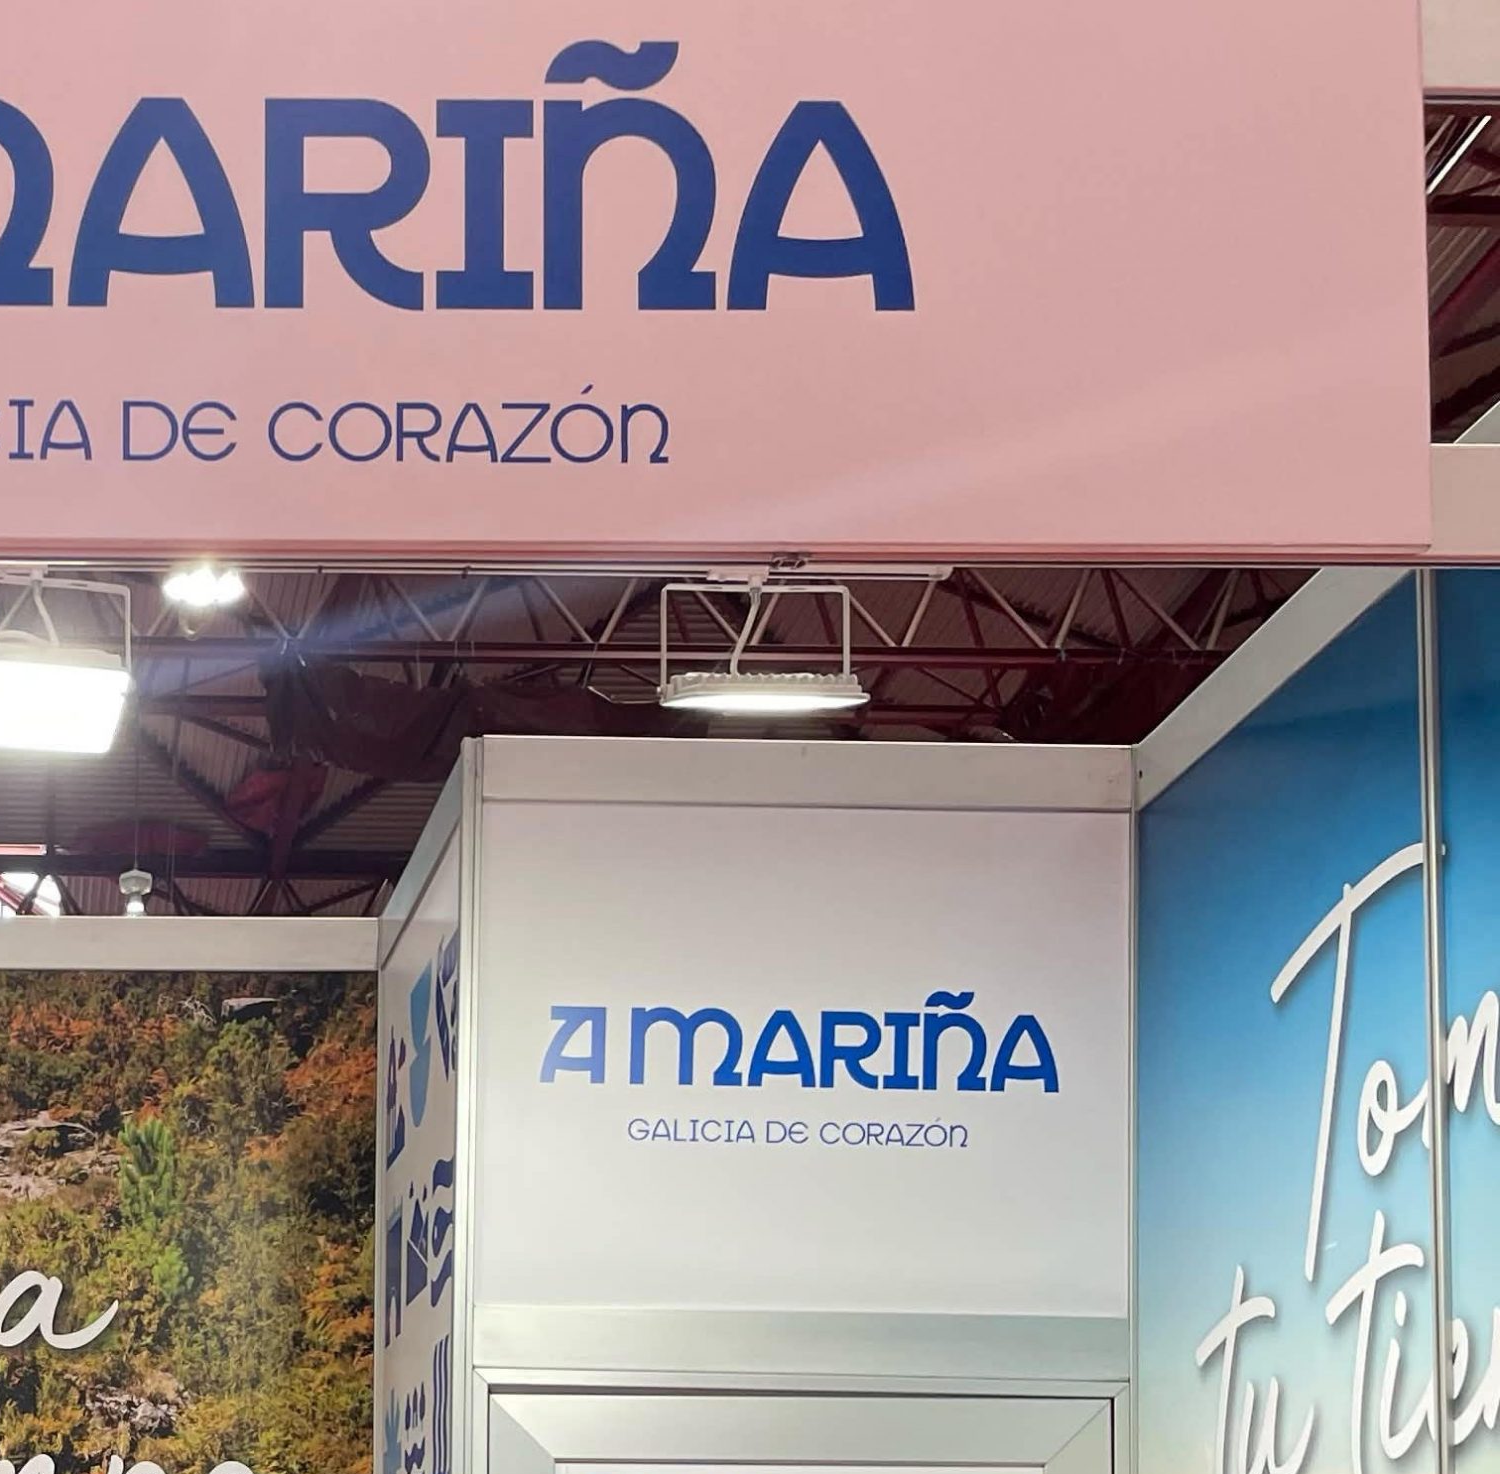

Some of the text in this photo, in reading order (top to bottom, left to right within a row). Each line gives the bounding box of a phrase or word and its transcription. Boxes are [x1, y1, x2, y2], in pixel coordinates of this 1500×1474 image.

[122, 399, 237, 461] DE
[268, 385, 671, 464] CORAZÓN
[540, 989, 1061, 1094] A MARIÑA
[628, 1117, 969, 1148] GALICIA DE CORAZÓN
